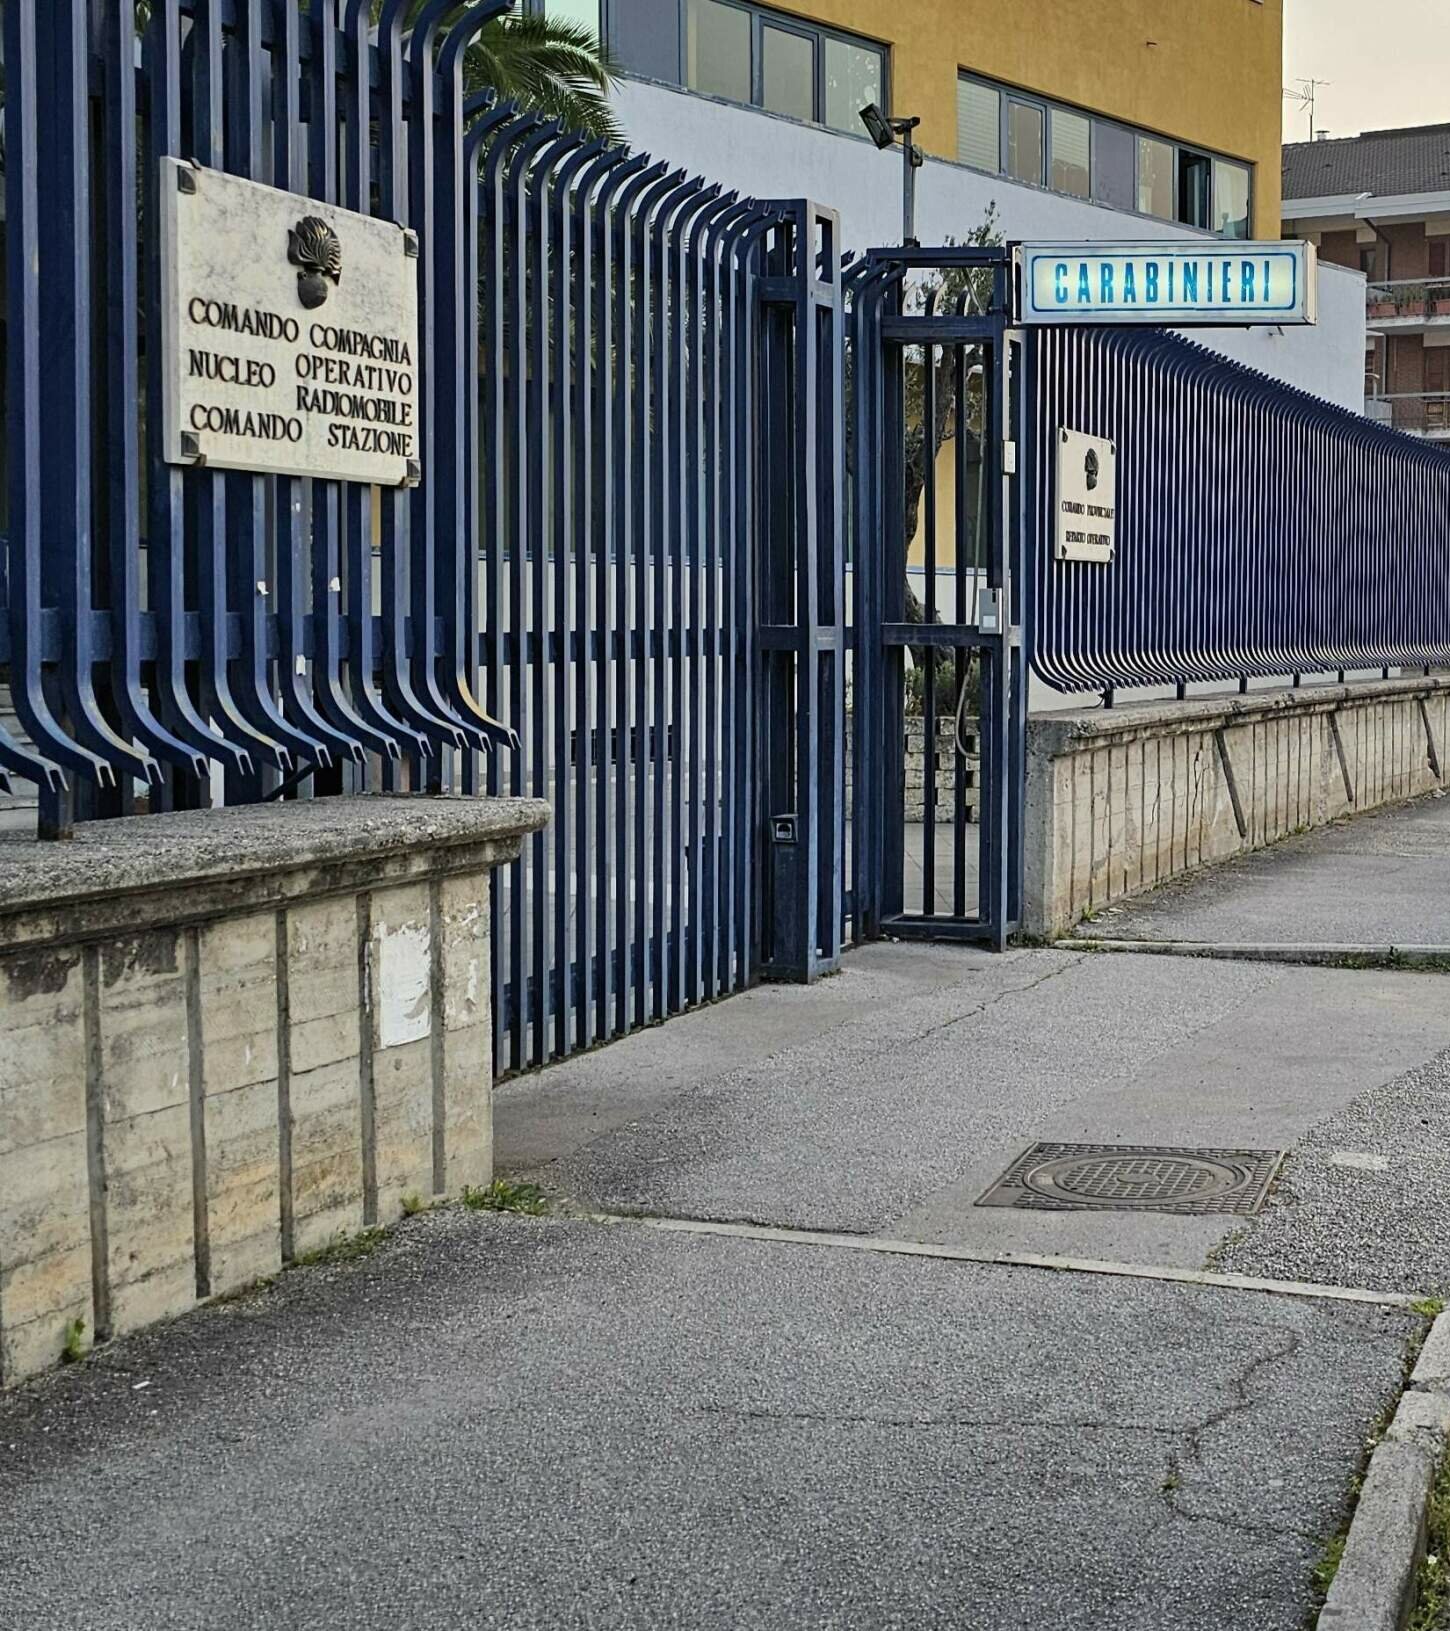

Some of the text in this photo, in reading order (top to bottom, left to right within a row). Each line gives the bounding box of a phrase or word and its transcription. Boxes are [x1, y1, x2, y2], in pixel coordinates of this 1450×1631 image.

[1055, 260, 1271, 304] CARABINIERI
[188, 297, 412, 366] COMANDO COMPAGNIA
[188, 349, 412, 395] NUCLEO OPERATIVO
[296, 385, 413, 427] RADIOMOBILE
[190, 404, 414, 457] COMANDO STAZIONE
